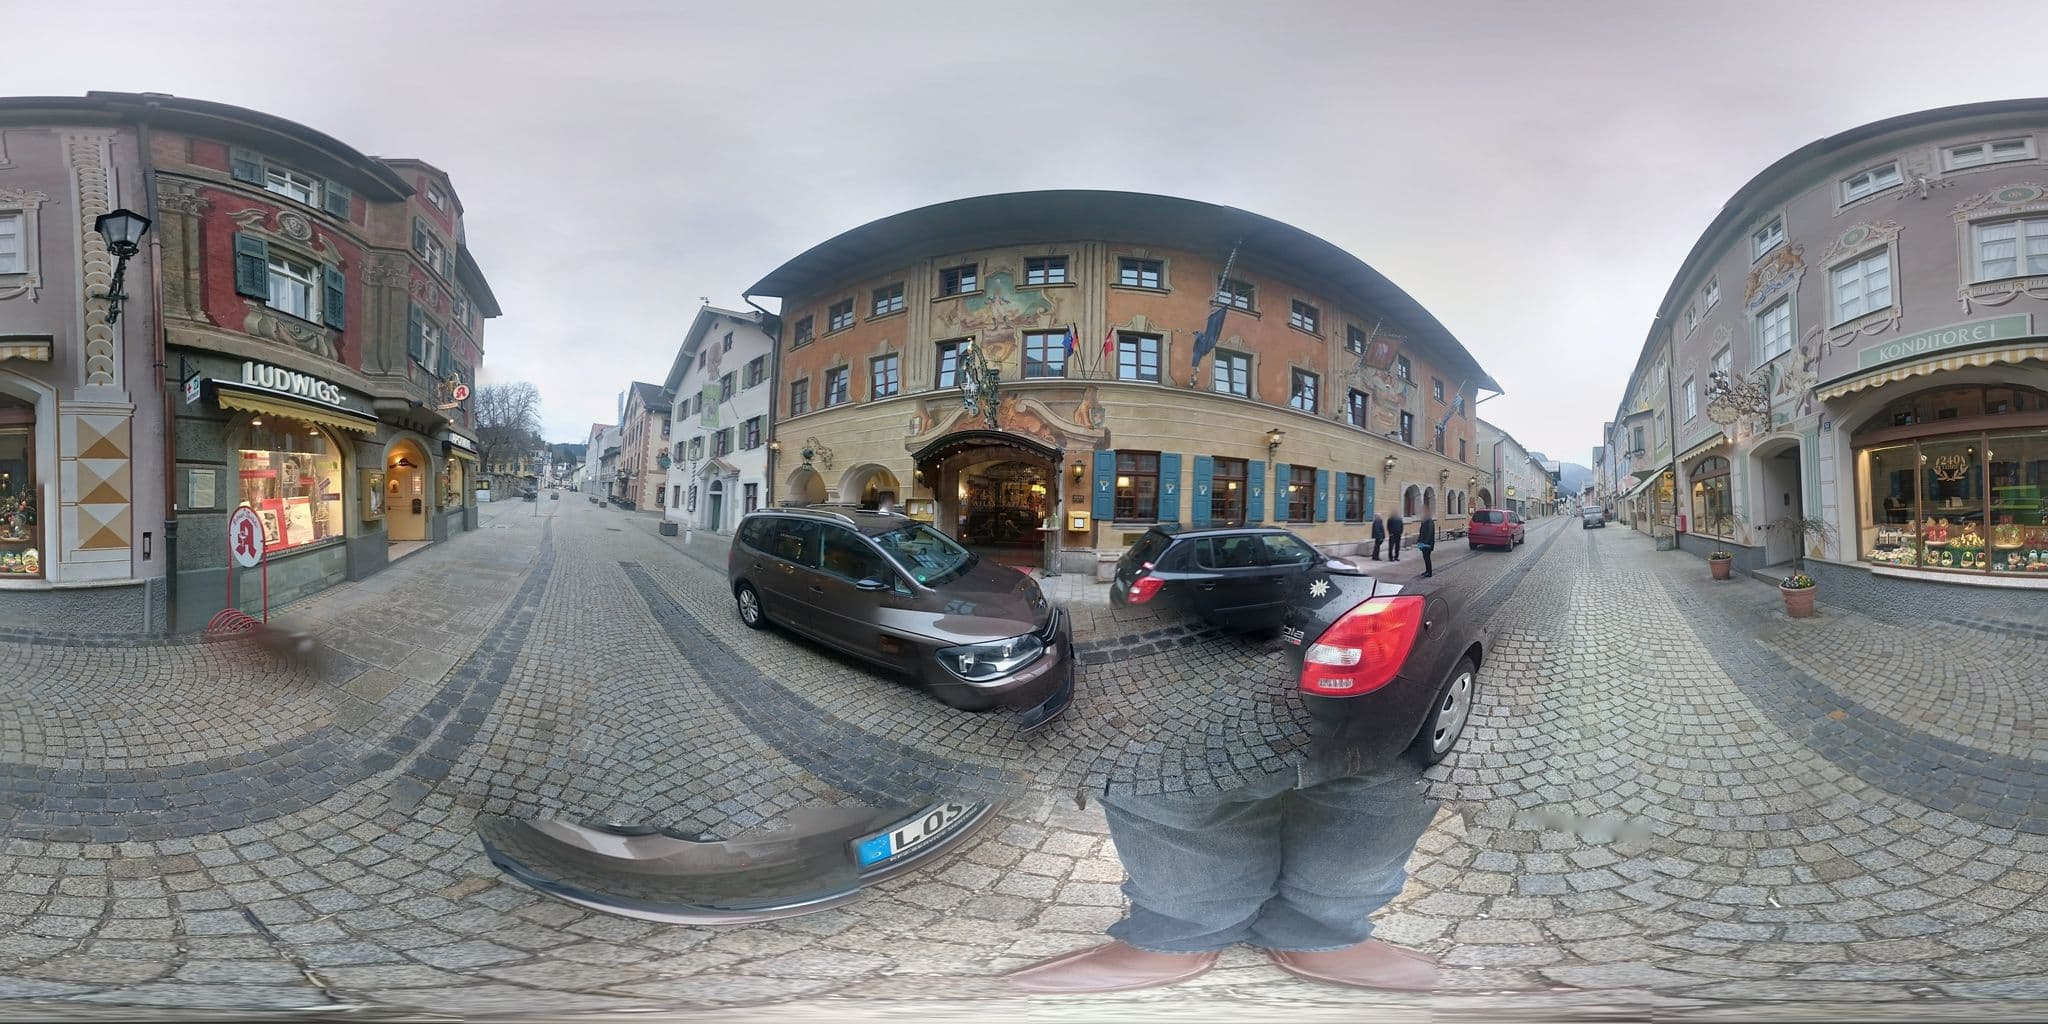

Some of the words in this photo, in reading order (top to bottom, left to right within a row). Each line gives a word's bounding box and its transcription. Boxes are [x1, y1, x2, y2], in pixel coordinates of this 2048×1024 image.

[1879, 324, 1995, 361] KONDITOREI
[242, 361, 347, 405] LUDWIGS-
[1940, 454, 1961, 466] 240
